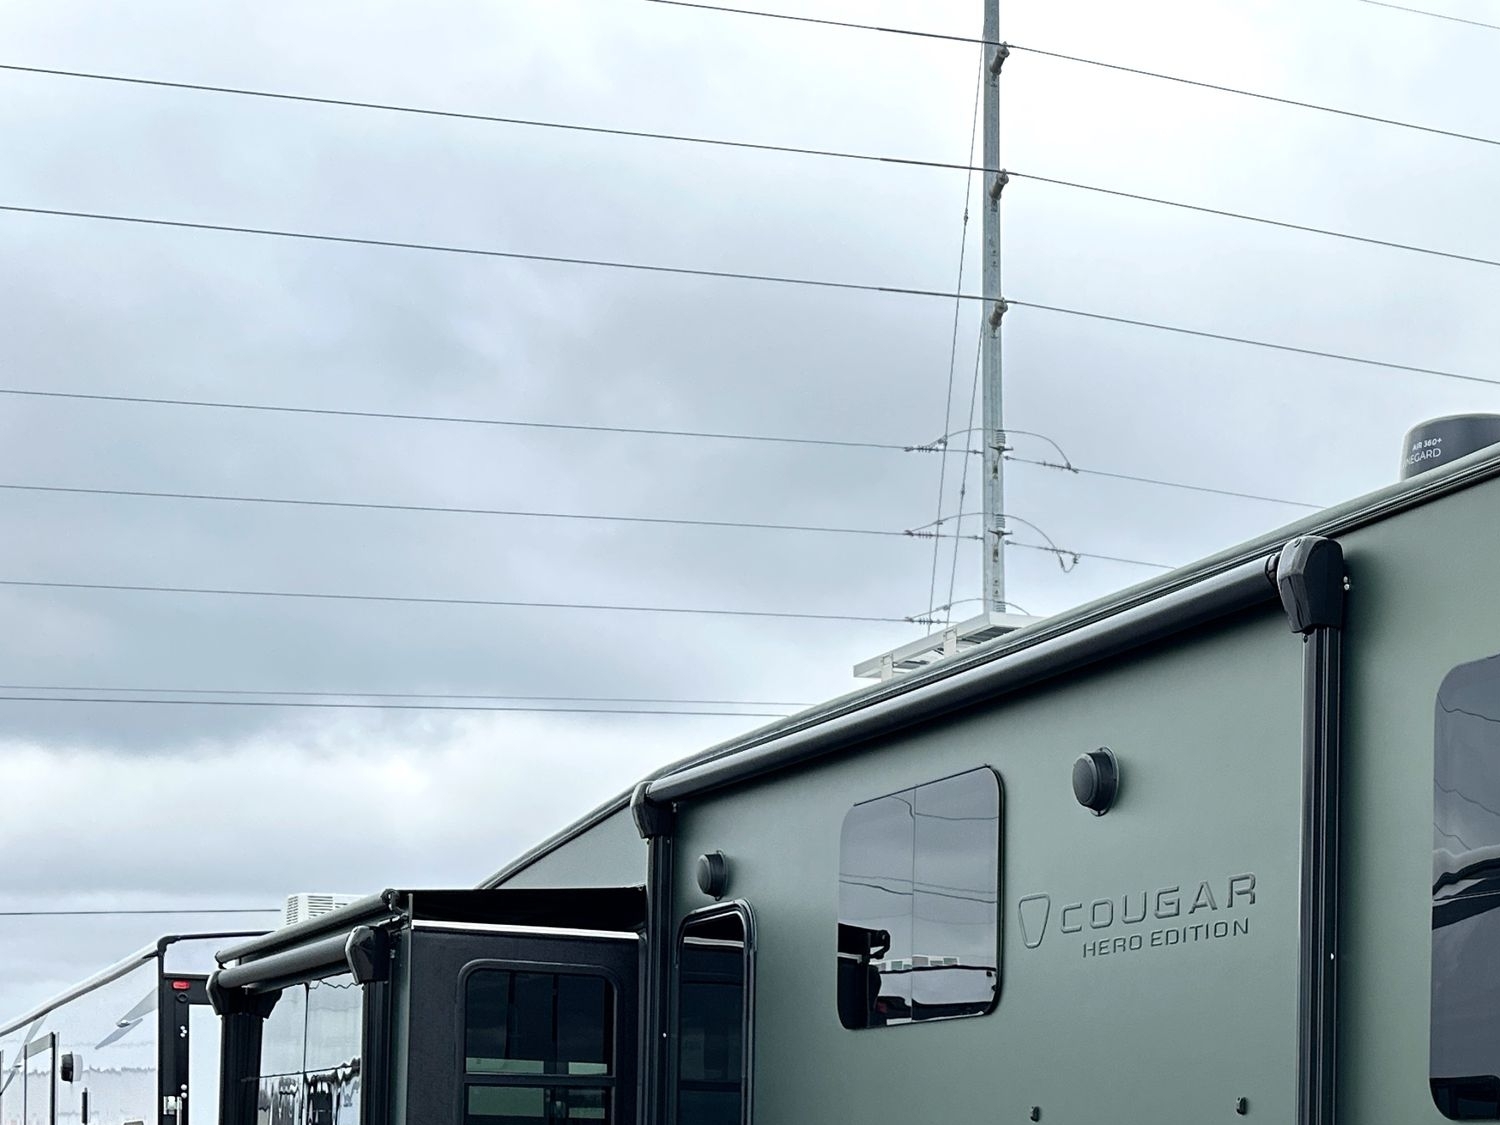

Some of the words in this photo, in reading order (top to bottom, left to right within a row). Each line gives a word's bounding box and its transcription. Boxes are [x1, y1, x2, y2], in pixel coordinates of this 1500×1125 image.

[1060, 872, 1256, 934] COUGAR
[1083, 934, 1143, 958] HERO
[1150, 917, 1250, 947] EDITION
